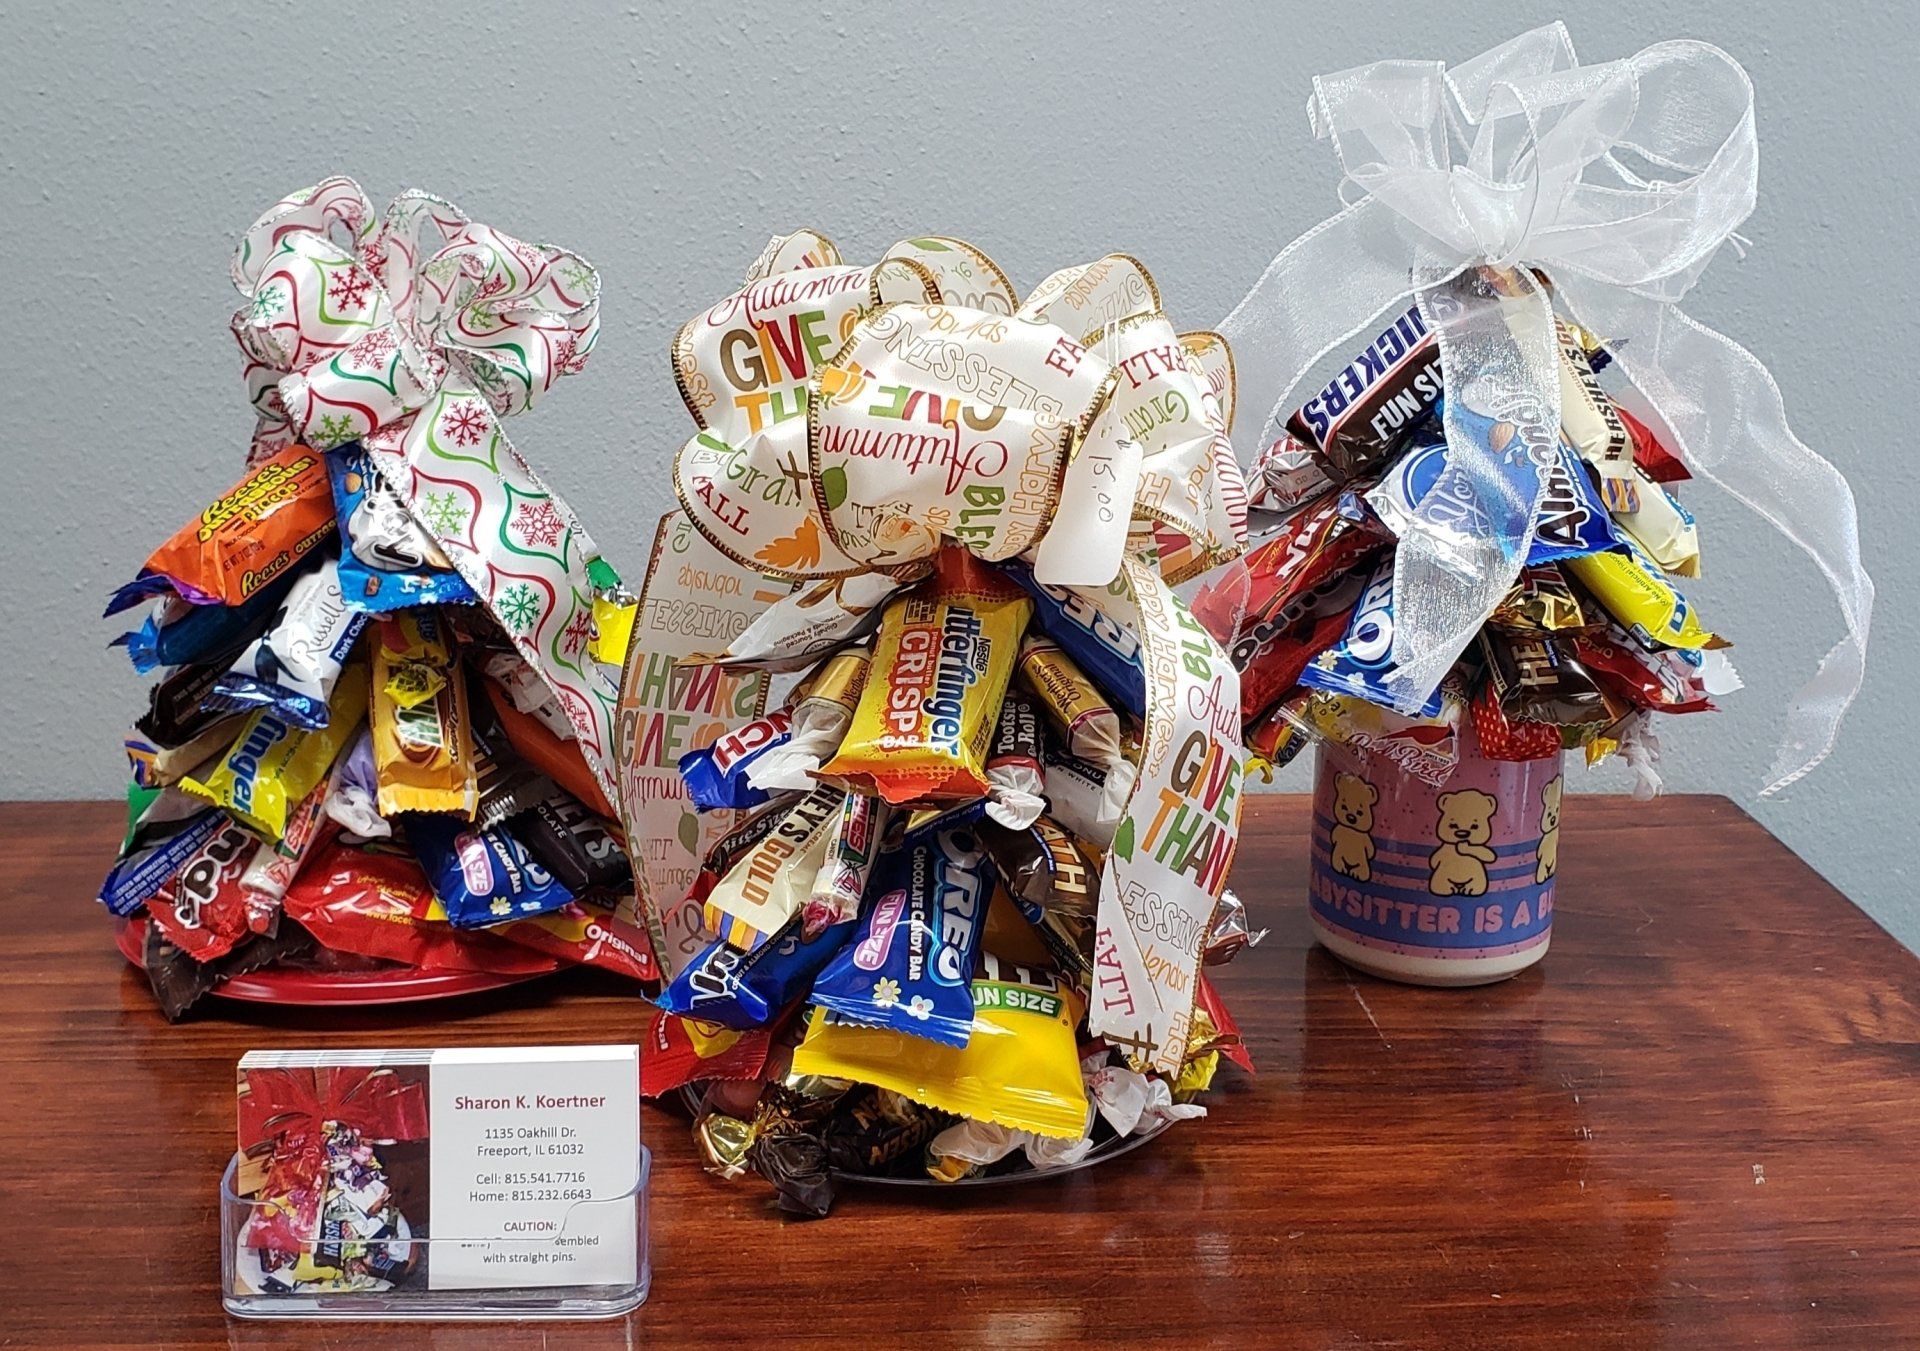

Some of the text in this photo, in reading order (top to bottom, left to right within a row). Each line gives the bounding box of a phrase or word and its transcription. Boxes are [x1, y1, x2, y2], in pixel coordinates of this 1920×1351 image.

[707, 273, 866, 330] Autumn
[719, 310, 833, 392] GIVE
[1370, 388, 1421, 442] FUN
[1565, 346, 1627, 462] HERSHEY'S
[818, 419, 1008, 495] Autumn
[201, 463, 283, 524] Reese's
[241, 550, 290, 598] Reese's
[290, 600, 346, 664] Russell
[334, 637, 353, 661] Dark
[785, 634, 813, 649] Sourced
[889, 631, 929, 732] CRISP
[1030, 664, 1076, 714] Werther's
[1043, 659, 1083, 703] Original
[998, 701, 1016, 753] Tootsie
[1018, 714, 1035, 744] Roll
[1068, 772, 1096, 792] WHITE
[1170, 730, 1241, 826] GIVE
[1397, 743, 1457, 787] Bird
[537, 805, 567, 840] OLATE
[1140, 787, 1236, 897] THAN
[493, 841, 522, 894] CANDY BAR
[828, 838, 838, 861] CANDY
[741, 838, 795, 907] GOLD
[879, 893, 900, 924] FUN
[909, 847, 927, 981] CHOCOLATE CANDY BAR
[937, 828, 988, 980] OREO
[1474, 905, 1503, 933] IS
[1512, 900, 1530, 929] A
[586, 924, 648, 965] Original
[747, 943, 772, 966] ALMOND
[1005, 989, 1057, 1014] SIZE
[455, 1094, 606, 1110] Sharon K. Koertner
[477, 1144, 584, 1158] Freeport, IL 61032
[485, 1127, 577, 1139] 1135 Oakhill Dr.
[469, 1189, 592, 1202] Home: 815.232.6643
[476, 1172, 586, 1185] Cell: 815.541.7716
[504, 1221, 557, 1232] CAUTION:
[554, 1236, 599, 1246] embled
[483, 1252, 577, 1264] with straight pins.
